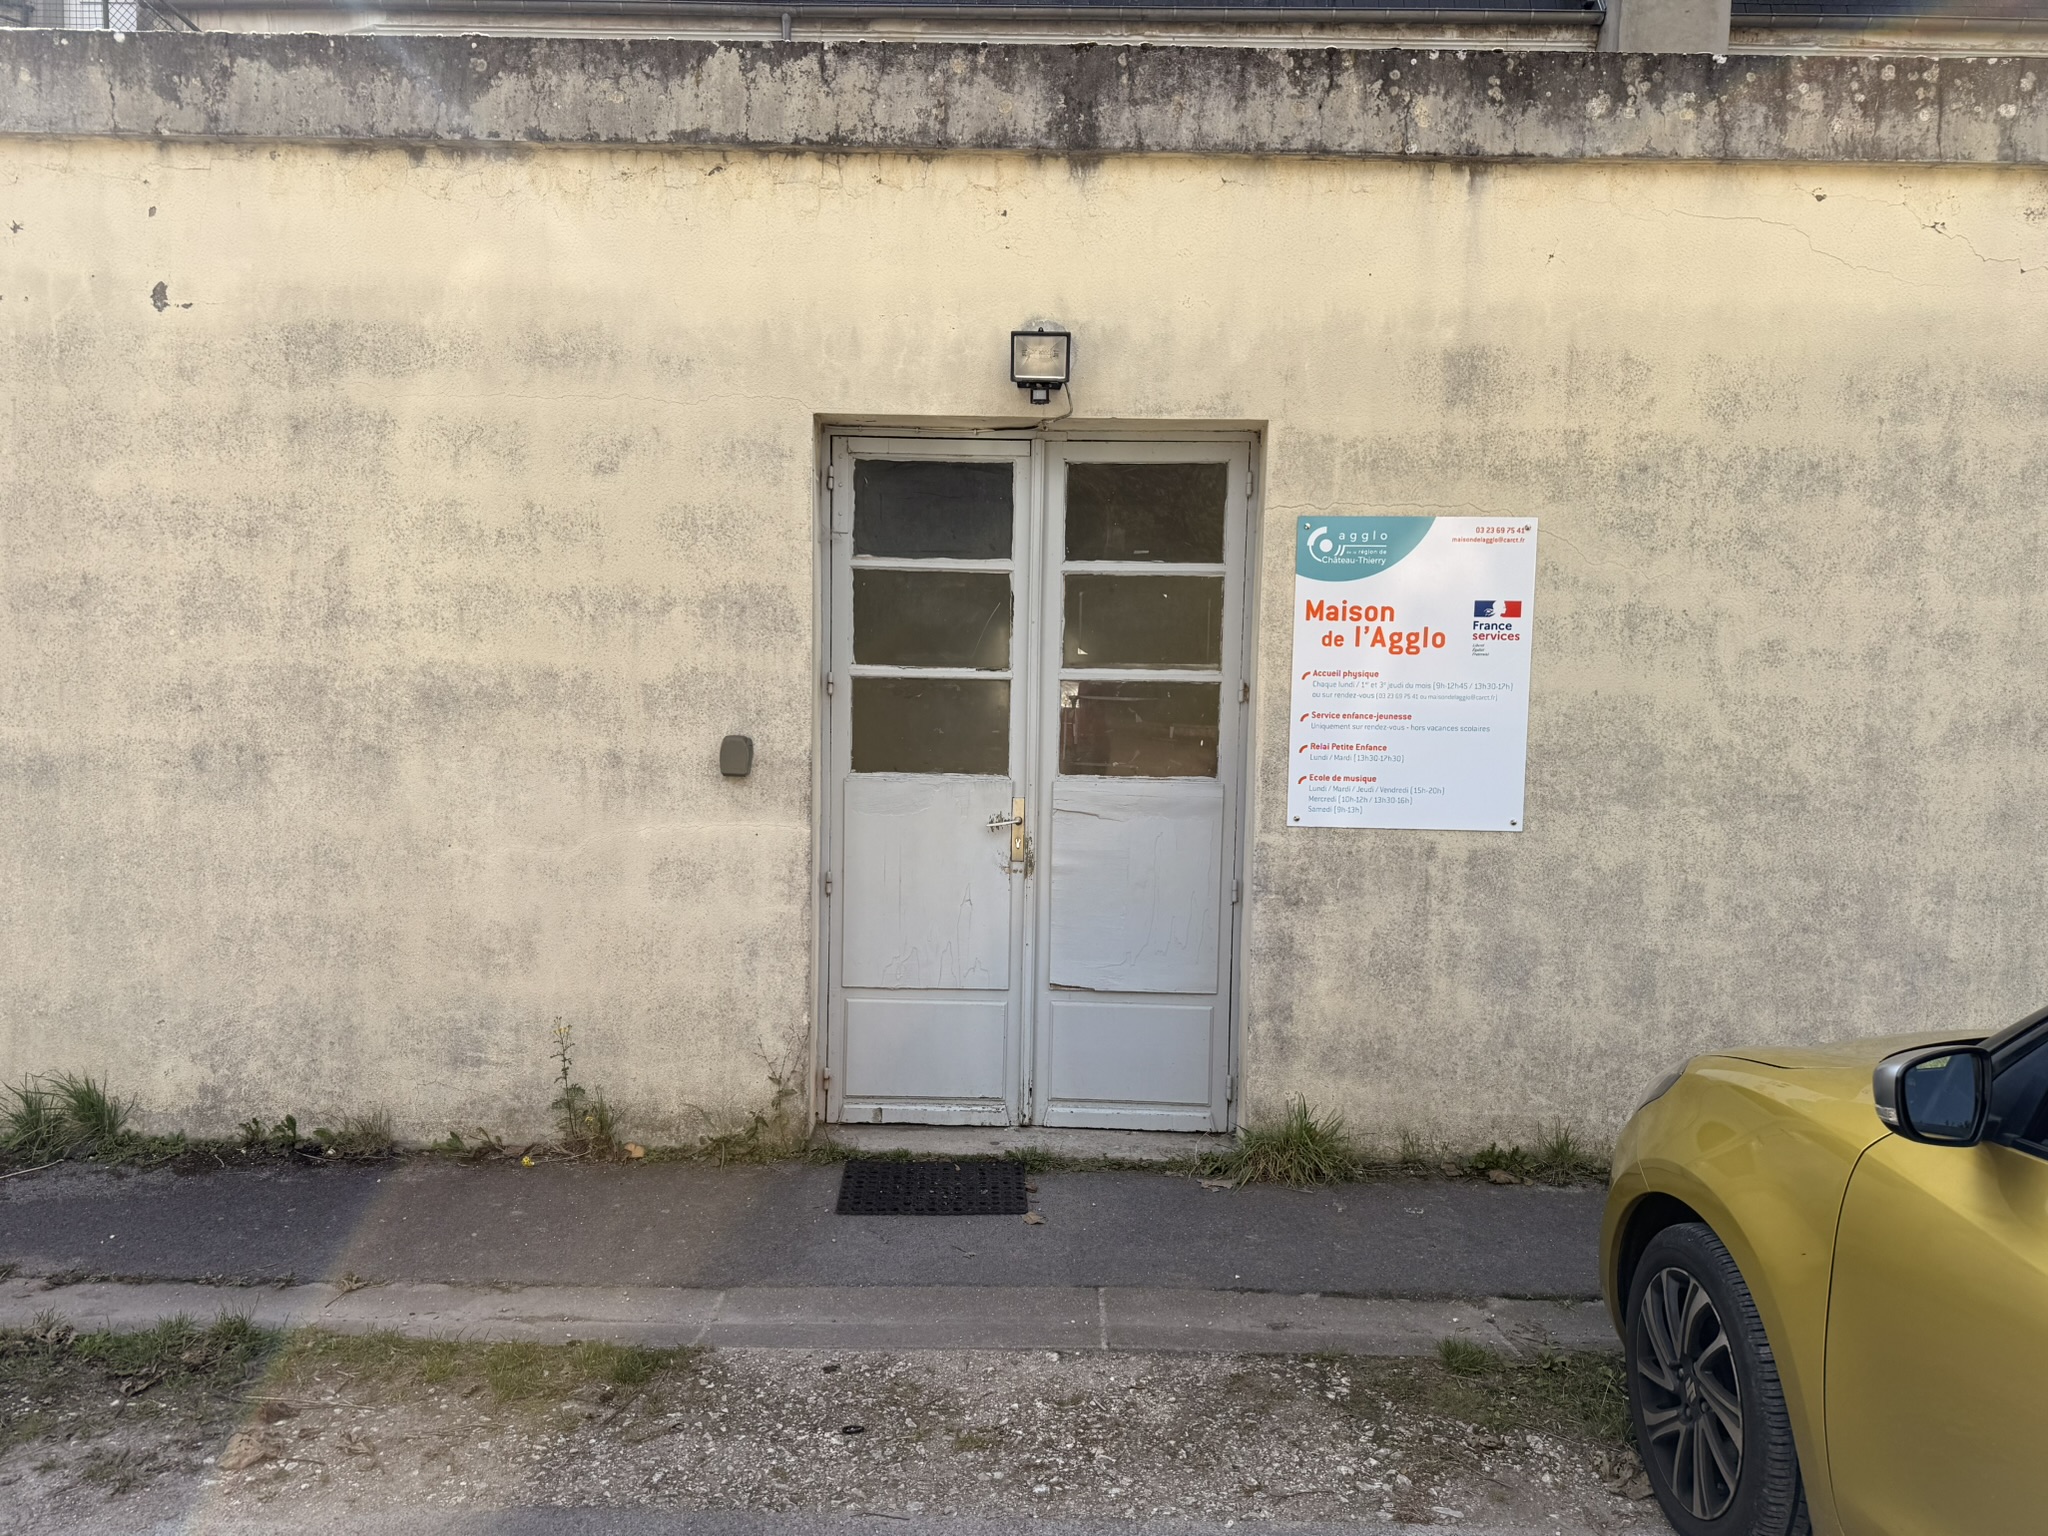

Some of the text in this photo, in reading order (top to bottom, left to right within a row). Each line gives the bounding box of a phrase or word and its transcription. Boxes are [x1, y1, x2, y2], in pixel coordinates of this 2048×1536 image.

[1339, 530, 1388, 542] agglo
[1322, 556, 1386, 566] Château-Thierry
[1305, 599, 1395, 622] Maison
[1473, 621, 1512, 630] France
[1472, 631, 1520, 640] services
[1321, 626, 1446, 655] de l'Agglo
[1343, 671, 1379, 679] physique
[1312, 681, 1337, 689] Chaque
[1387, 682, 1404, 690] jeudi
[1312, 711, 1412, 721] Service enfance-jeunesse
[1311, 723, 1351, 731] Uniquement
[1364, 723, 1405, 731] rendez-vous
[1331, 743, 1354, 751] Petite
[1344, 775, 1377, 784] musique
[1380, 786, 1409, 794] Vendredi
